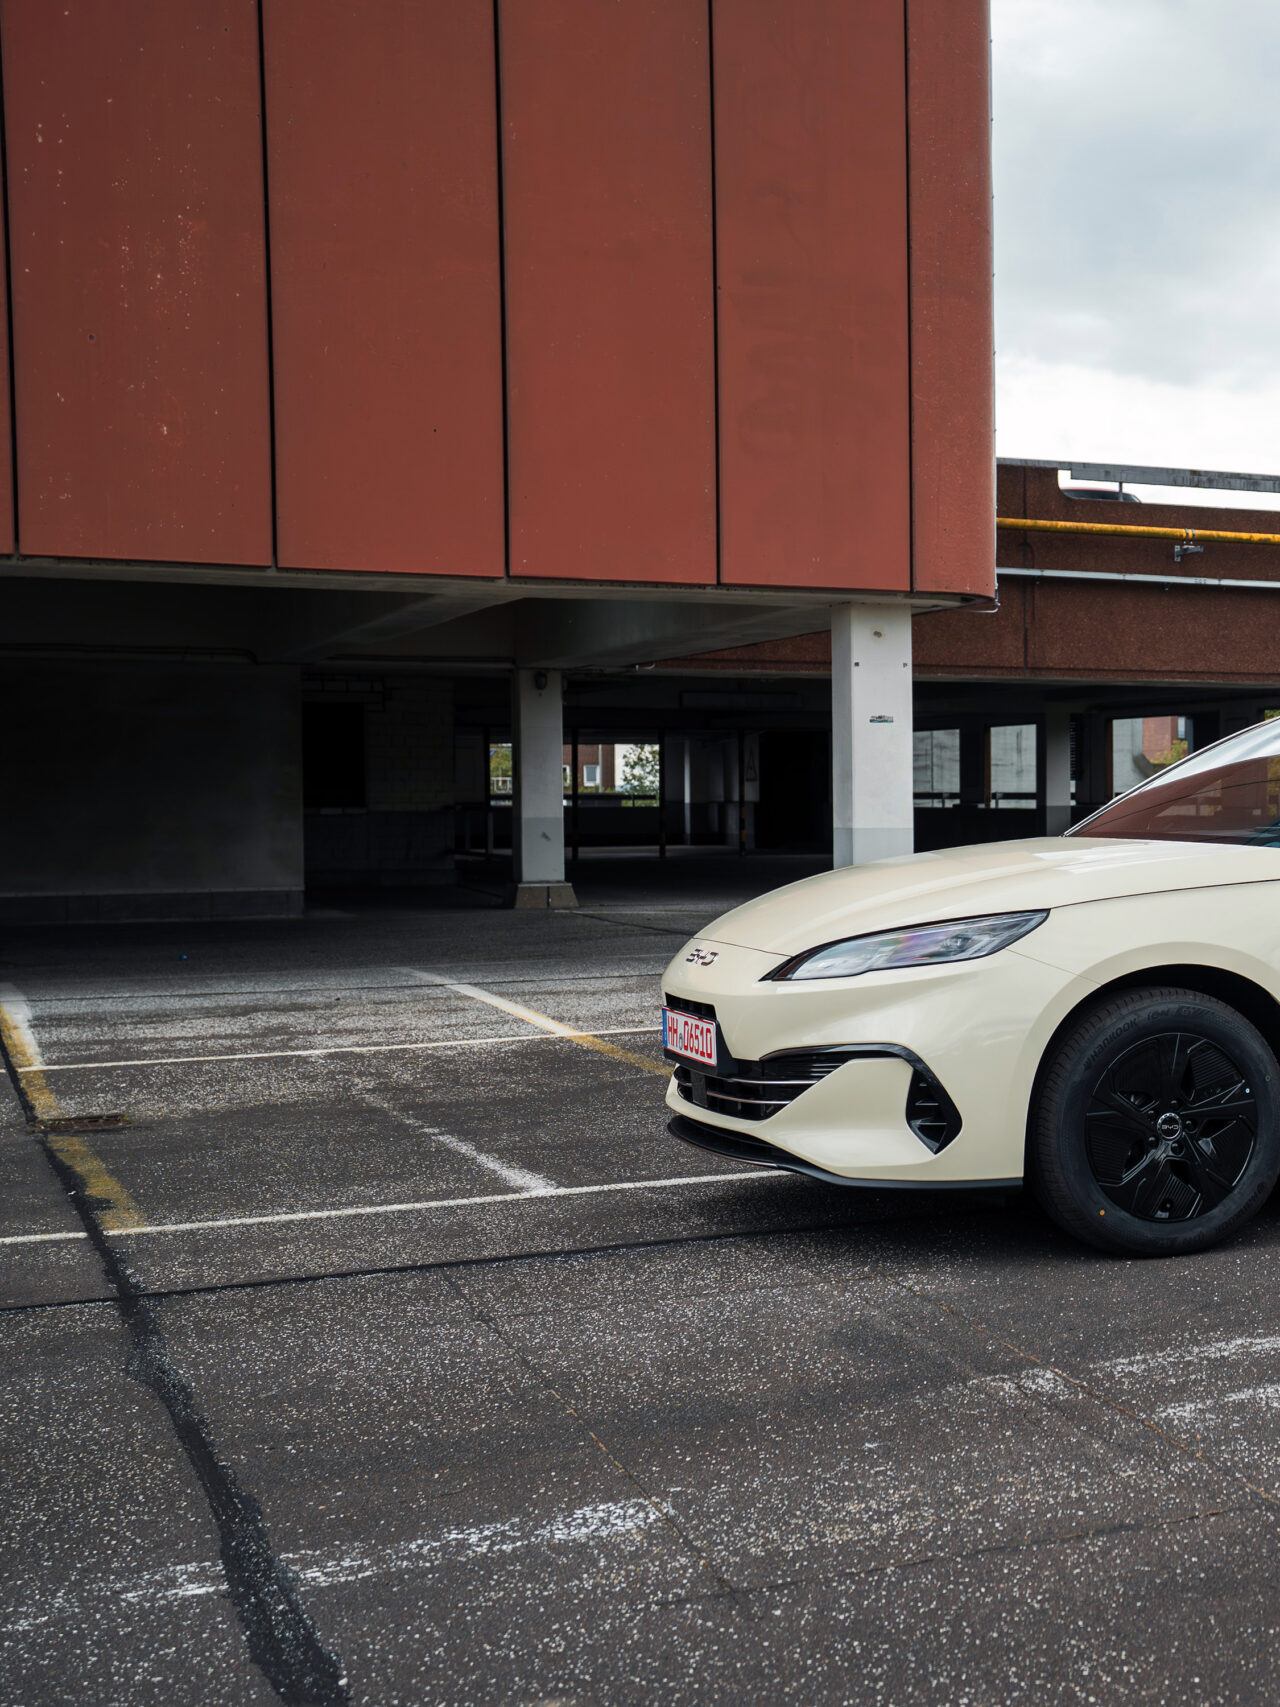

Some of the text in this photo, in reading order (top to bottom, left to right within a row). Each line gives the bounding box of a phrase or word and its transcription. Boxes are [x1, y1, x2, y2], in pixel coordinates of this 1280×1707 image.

[686, 948, 719, 966] BYD
[668, 1015, 712, 1059] HH 06510
